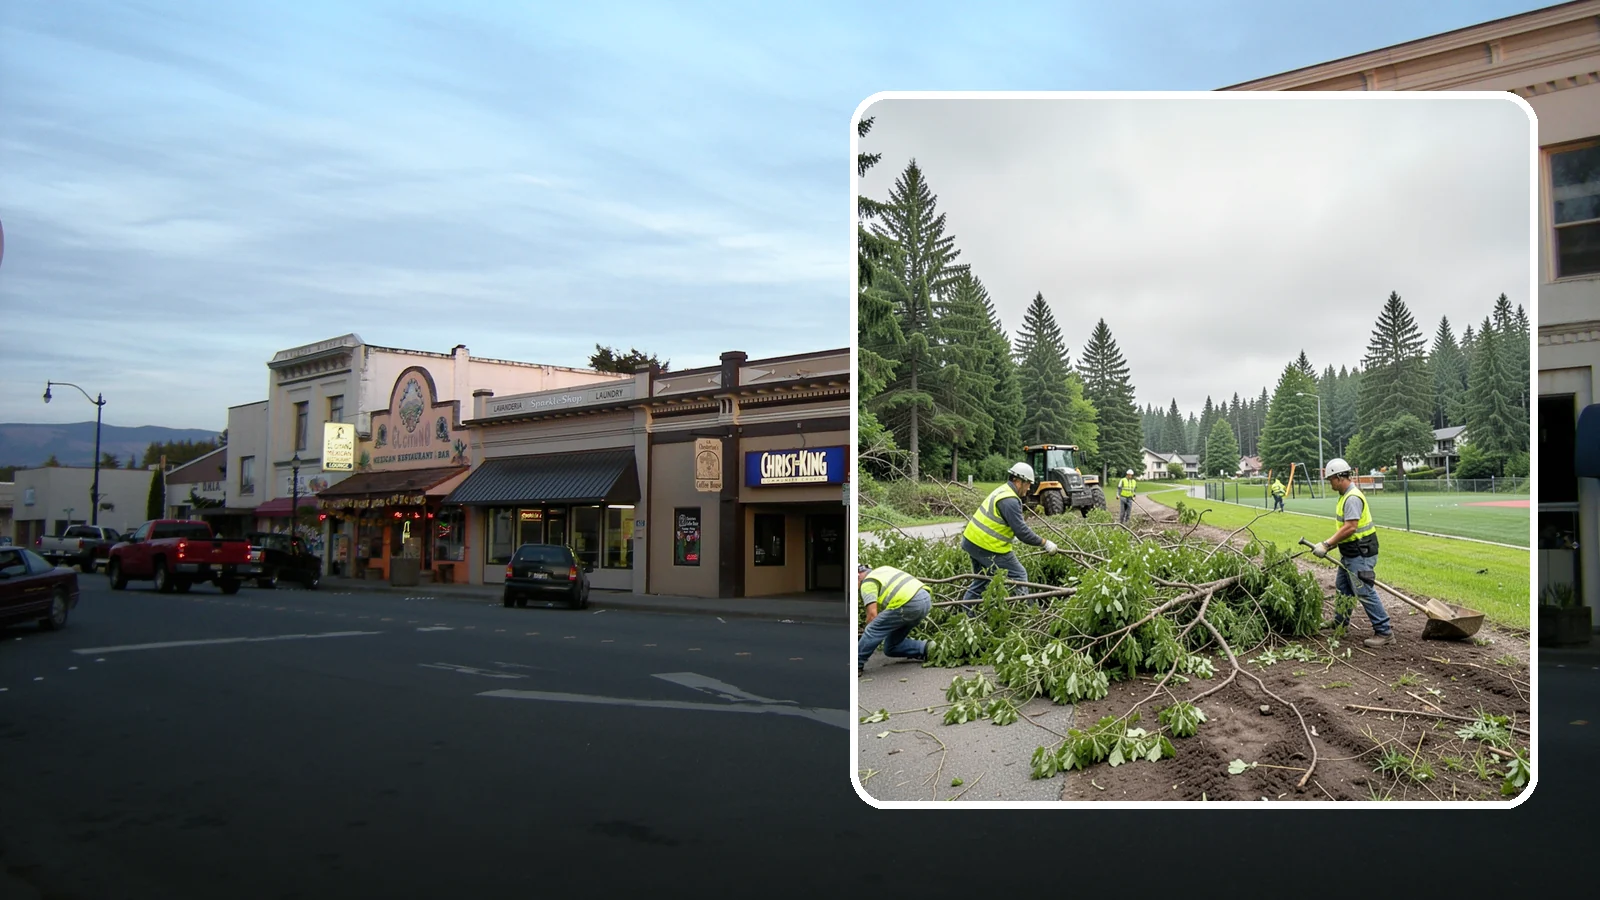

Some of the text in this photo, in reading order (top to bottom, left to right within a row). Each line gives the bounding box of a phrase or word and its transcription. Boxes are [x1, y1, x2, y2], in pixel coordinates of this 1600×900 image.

[493, 389, 623, 412] LAVANDERIA Sparkle Shop LAUNDRY
[397, 451, 433, 462] RESTAURANT
[438, 450, 450, 459] BAR
[761, 450, 827, 477] CHRIST KING
